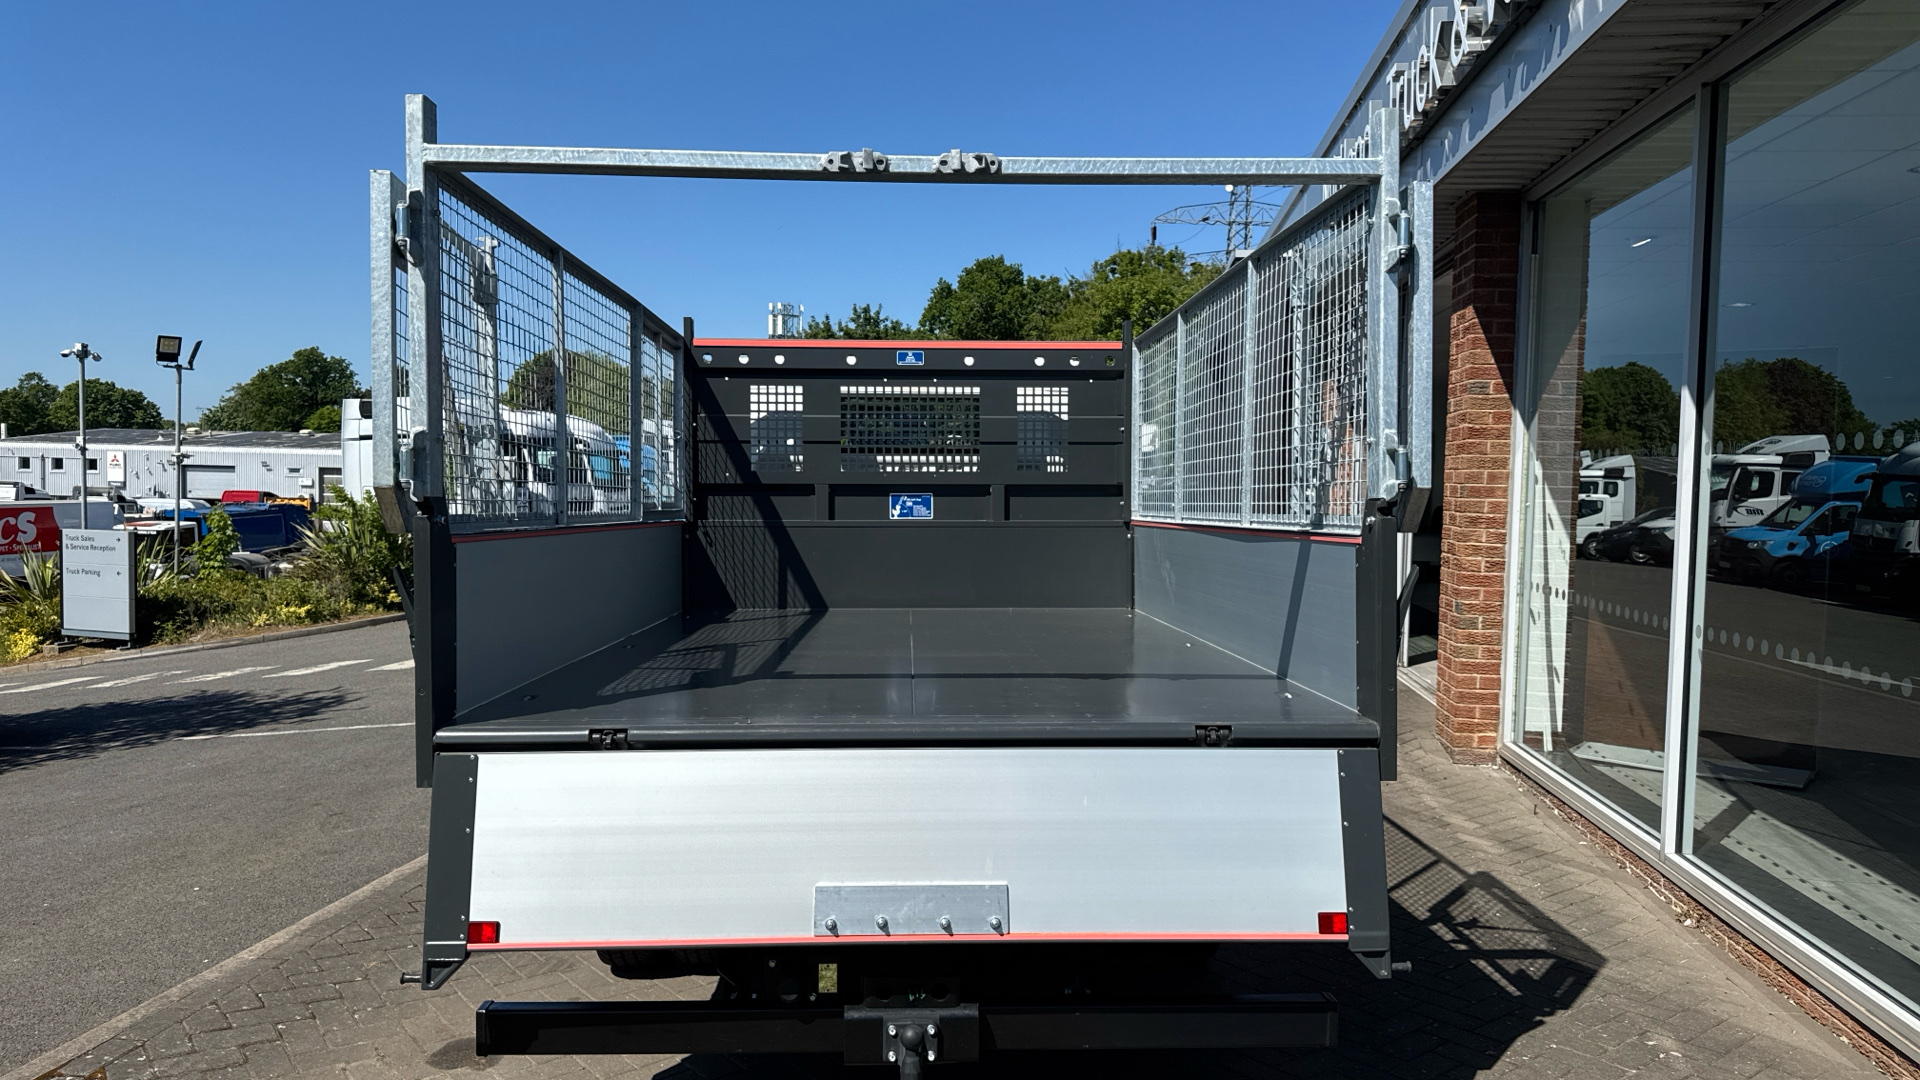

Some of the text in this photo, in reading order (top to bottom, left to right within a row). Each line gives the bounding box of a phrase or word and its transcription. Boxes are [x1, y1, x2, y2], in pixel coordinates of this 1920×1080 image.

[90, 544, 116, 552] Reception
[66, 567, 101, 577] Truck Parking
